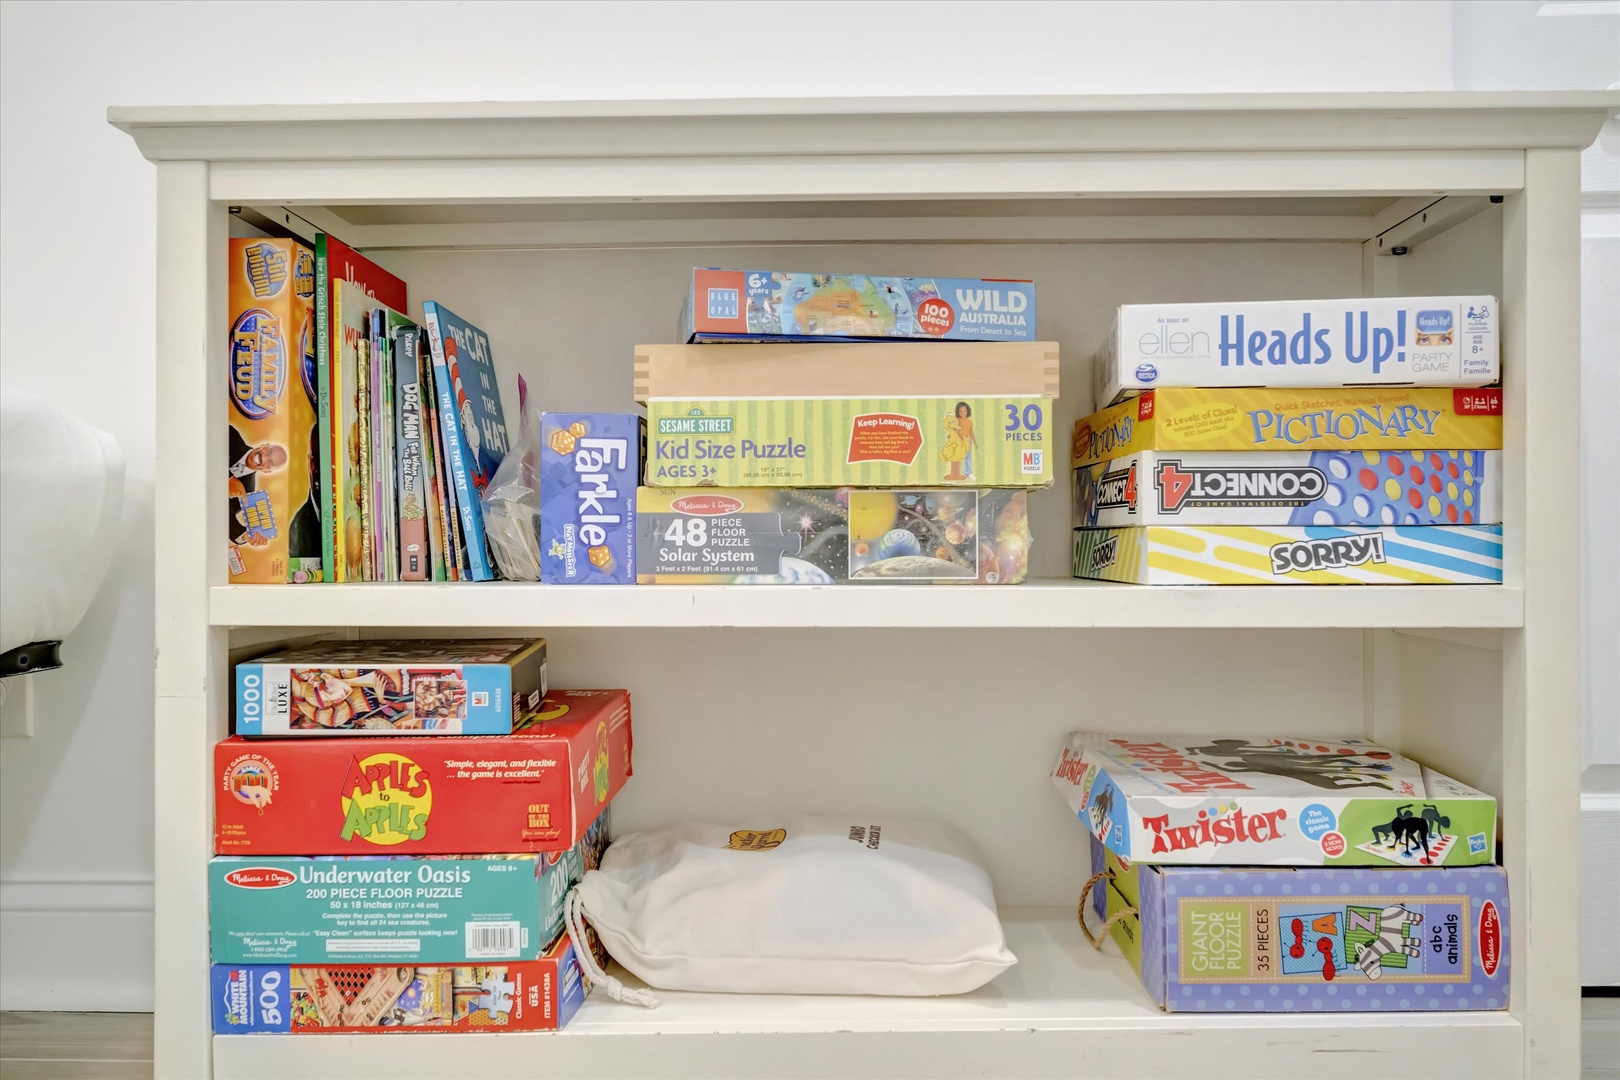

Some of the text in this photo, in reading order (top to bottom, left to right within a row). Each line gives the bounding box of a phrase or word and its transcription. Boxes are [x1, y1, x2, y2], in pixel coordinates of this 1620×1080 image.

[749, 274, 767, 287] 6+
[710, 292, 736, 300] BLUE
[956, 289, 1027, 313] WILD
[317, 257, 326, 366] How the Grinch Stole Christmas
[710, 307, 736, 315] OPAL
[921, 315, 949, 327] pieces
[924, 304, 949, 318] 100
[959, 312, 1026, 326] AUSTRALIA
[1419, 316, 1450, 326] Heads Up!
[448, 324, 466, 350] THE
[960, 326, 979, 334] From
[981, 327, 1003, 335] Desert
[1139, 326, 1210, 355] ellen
[1218, 310, 1407, 374] Heads Up!
[464, 328, 489, 366] CAT
[1412, 353, 1453, 362] PARTY
[234, 329, 260, 400] FEUD
[254, 318, 280, 415] FAMILY
[1412, 363, 1450, 372] GAME
[480, 372, 490, 390] IN
[403, 383, 419, 439] DOG MAN
[482, 395, 497, 415] THE
[1005, 404, 1043, 431] 30
[1165, 405, 1238, 427] 2 Levels of Clues!
[1274, 402, 1299, 411] Quick
[660, 419, 731, 432] SESAME STREET
[857, 418, 914, 430] Keep Learning!
[1246, 404, 1440, 444] PICTIONARY
[442, 392, 466, 491] THE CAT IN THE HAT
[656, 438, 806, 459] Kid Size Puzzle
[1006, 433, 1042, 441] PIECES
[1089, 415, 1135, 459] PICTIONARY
[657, 465, 716, 478] AGES 3+
[1024, 453, 1041, 465] MB
[575, 438, 628, 546] Farkle
[1098, 466, 1136, 508] CONNECT 4
[1160, 466, 1323, 508] CONNECT 4
[664, 519, 707, 546] 48
[660, 548, 754, 565] Solar System
[1091, 539, 1116, 571] SORRY!
[1273, 537, 1382, 571] SORRY!
[243, 675, 260, 724] 1000
[278, 684, 287, 713] LUXE
[223, 768, 234, 791] PARTY
[231, 754, 250, 768] GAME
[262, 756, 272, 768] THE
[271, 765, 279, 791] YEAR
[444, 760, 475, 769] "Simple,
[476, 760, 508, 769] elegant,
[527, 759, 556, 769] flexible
[1056, 747, 1088, 786] Twister
[340, 755, 430, 799] APPLES
[379, 793, 390, 801] to
[529, 804, 549, 813] OUT
[339, 798, 429, 842] APPLES
[529, 819, 549, 828] BOX
[1142, 806, 1287, 854] Twister
[1305, 816, 1329, 825] classic
[1308, 823, 1330, 834] game
[300, 865, 471, 884] Underwater Oasis
[550, 858, 568, 907] 200
[306, 888, 463, 899] 200 PIECE FLOOR PUZZLE
[363, 901, 392, 909] inches
[1312, 913, 1337, 936] A
[1349, 910, 1376, 935] Z
[1191, 910, 1209, 972] GIANT
[1209, 912, 1225, 970] FLOOR
[1226, 912, 1242, 969] PUZZLE
[1257, 909, 1270, 971] 35 PIECES
[1430, 925, 1443, 953] abc
[1446, 914, 1458, 965] animals
[239, 970, 248, 1024] MOUNTAIN
[260, 971, 282, 1025] 500
[531, 985, 539, 1007] USA
